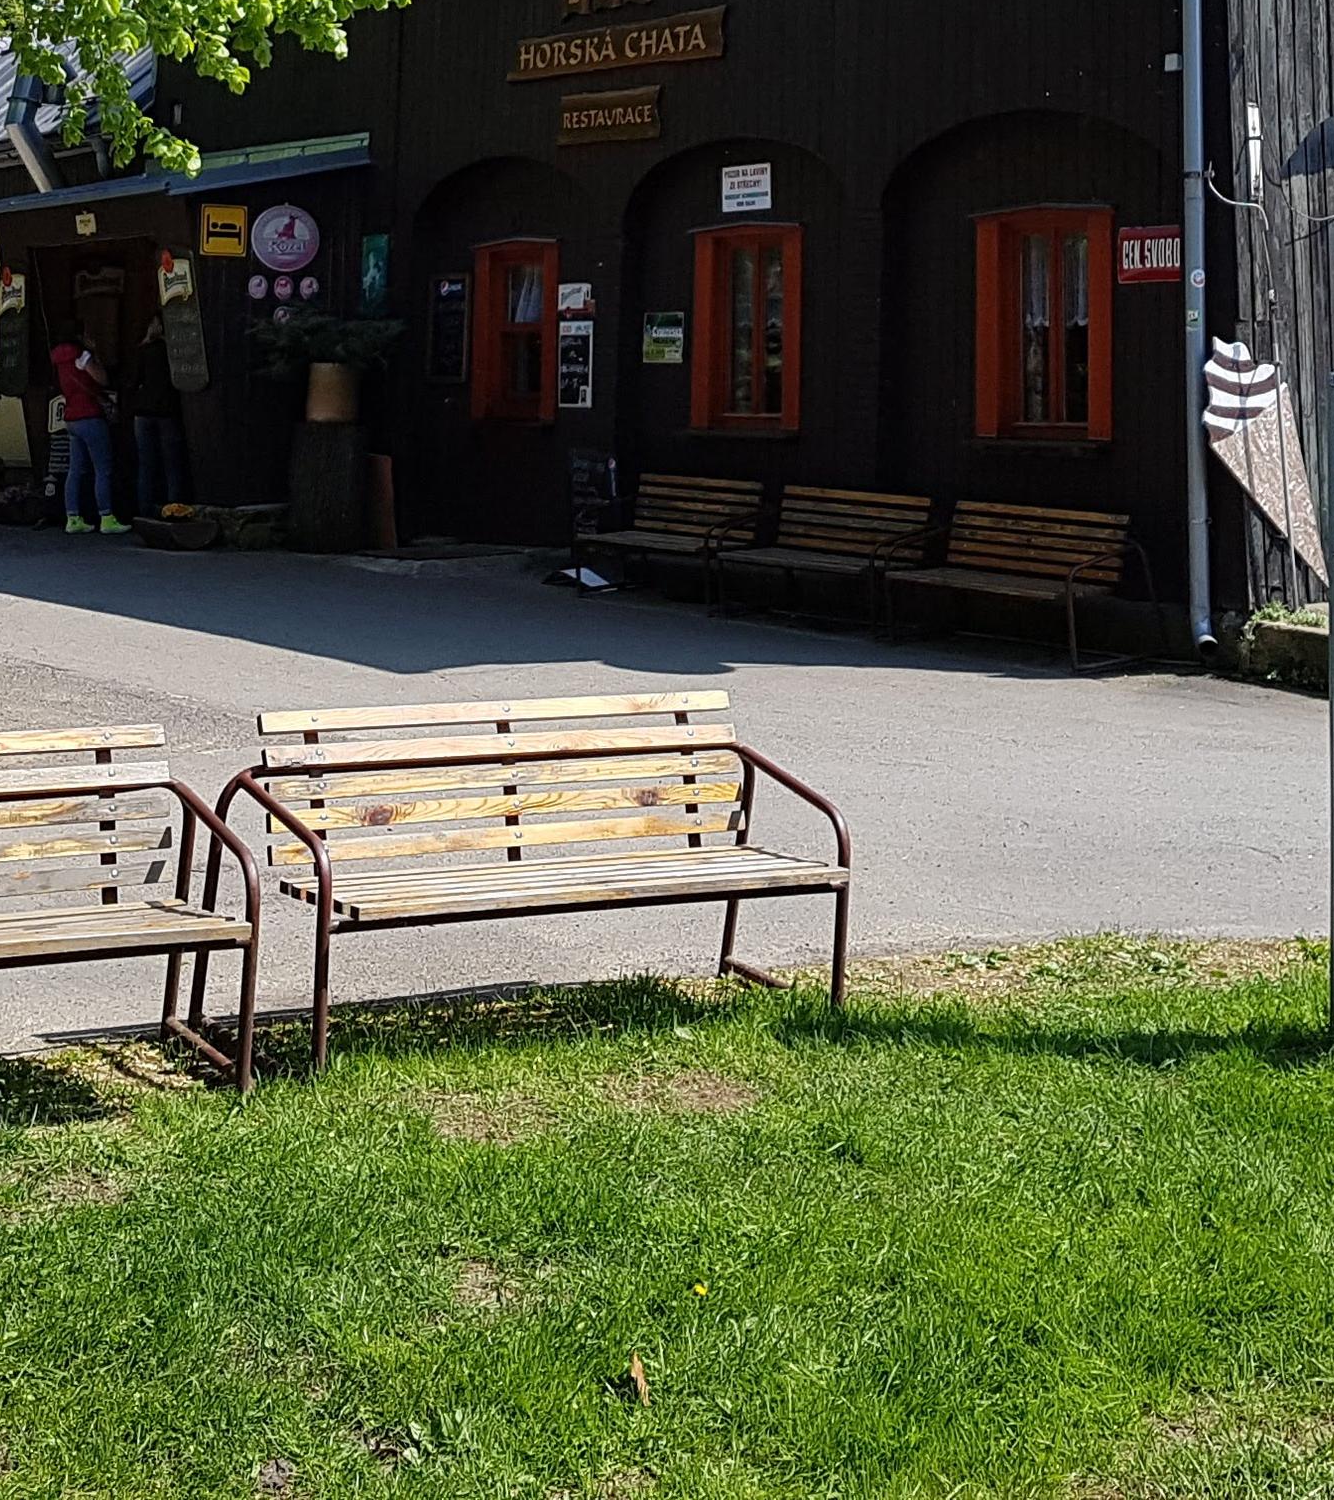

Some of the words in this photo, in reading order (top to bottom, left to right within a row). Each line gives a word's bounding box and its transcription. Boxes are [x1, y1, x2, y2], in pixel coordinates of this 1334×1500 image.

[520, 29, 617, 70] HORSKÁ
[624, 23, 707, 59] CHATA
[1144, 238, 1181, 268] SVOBO
